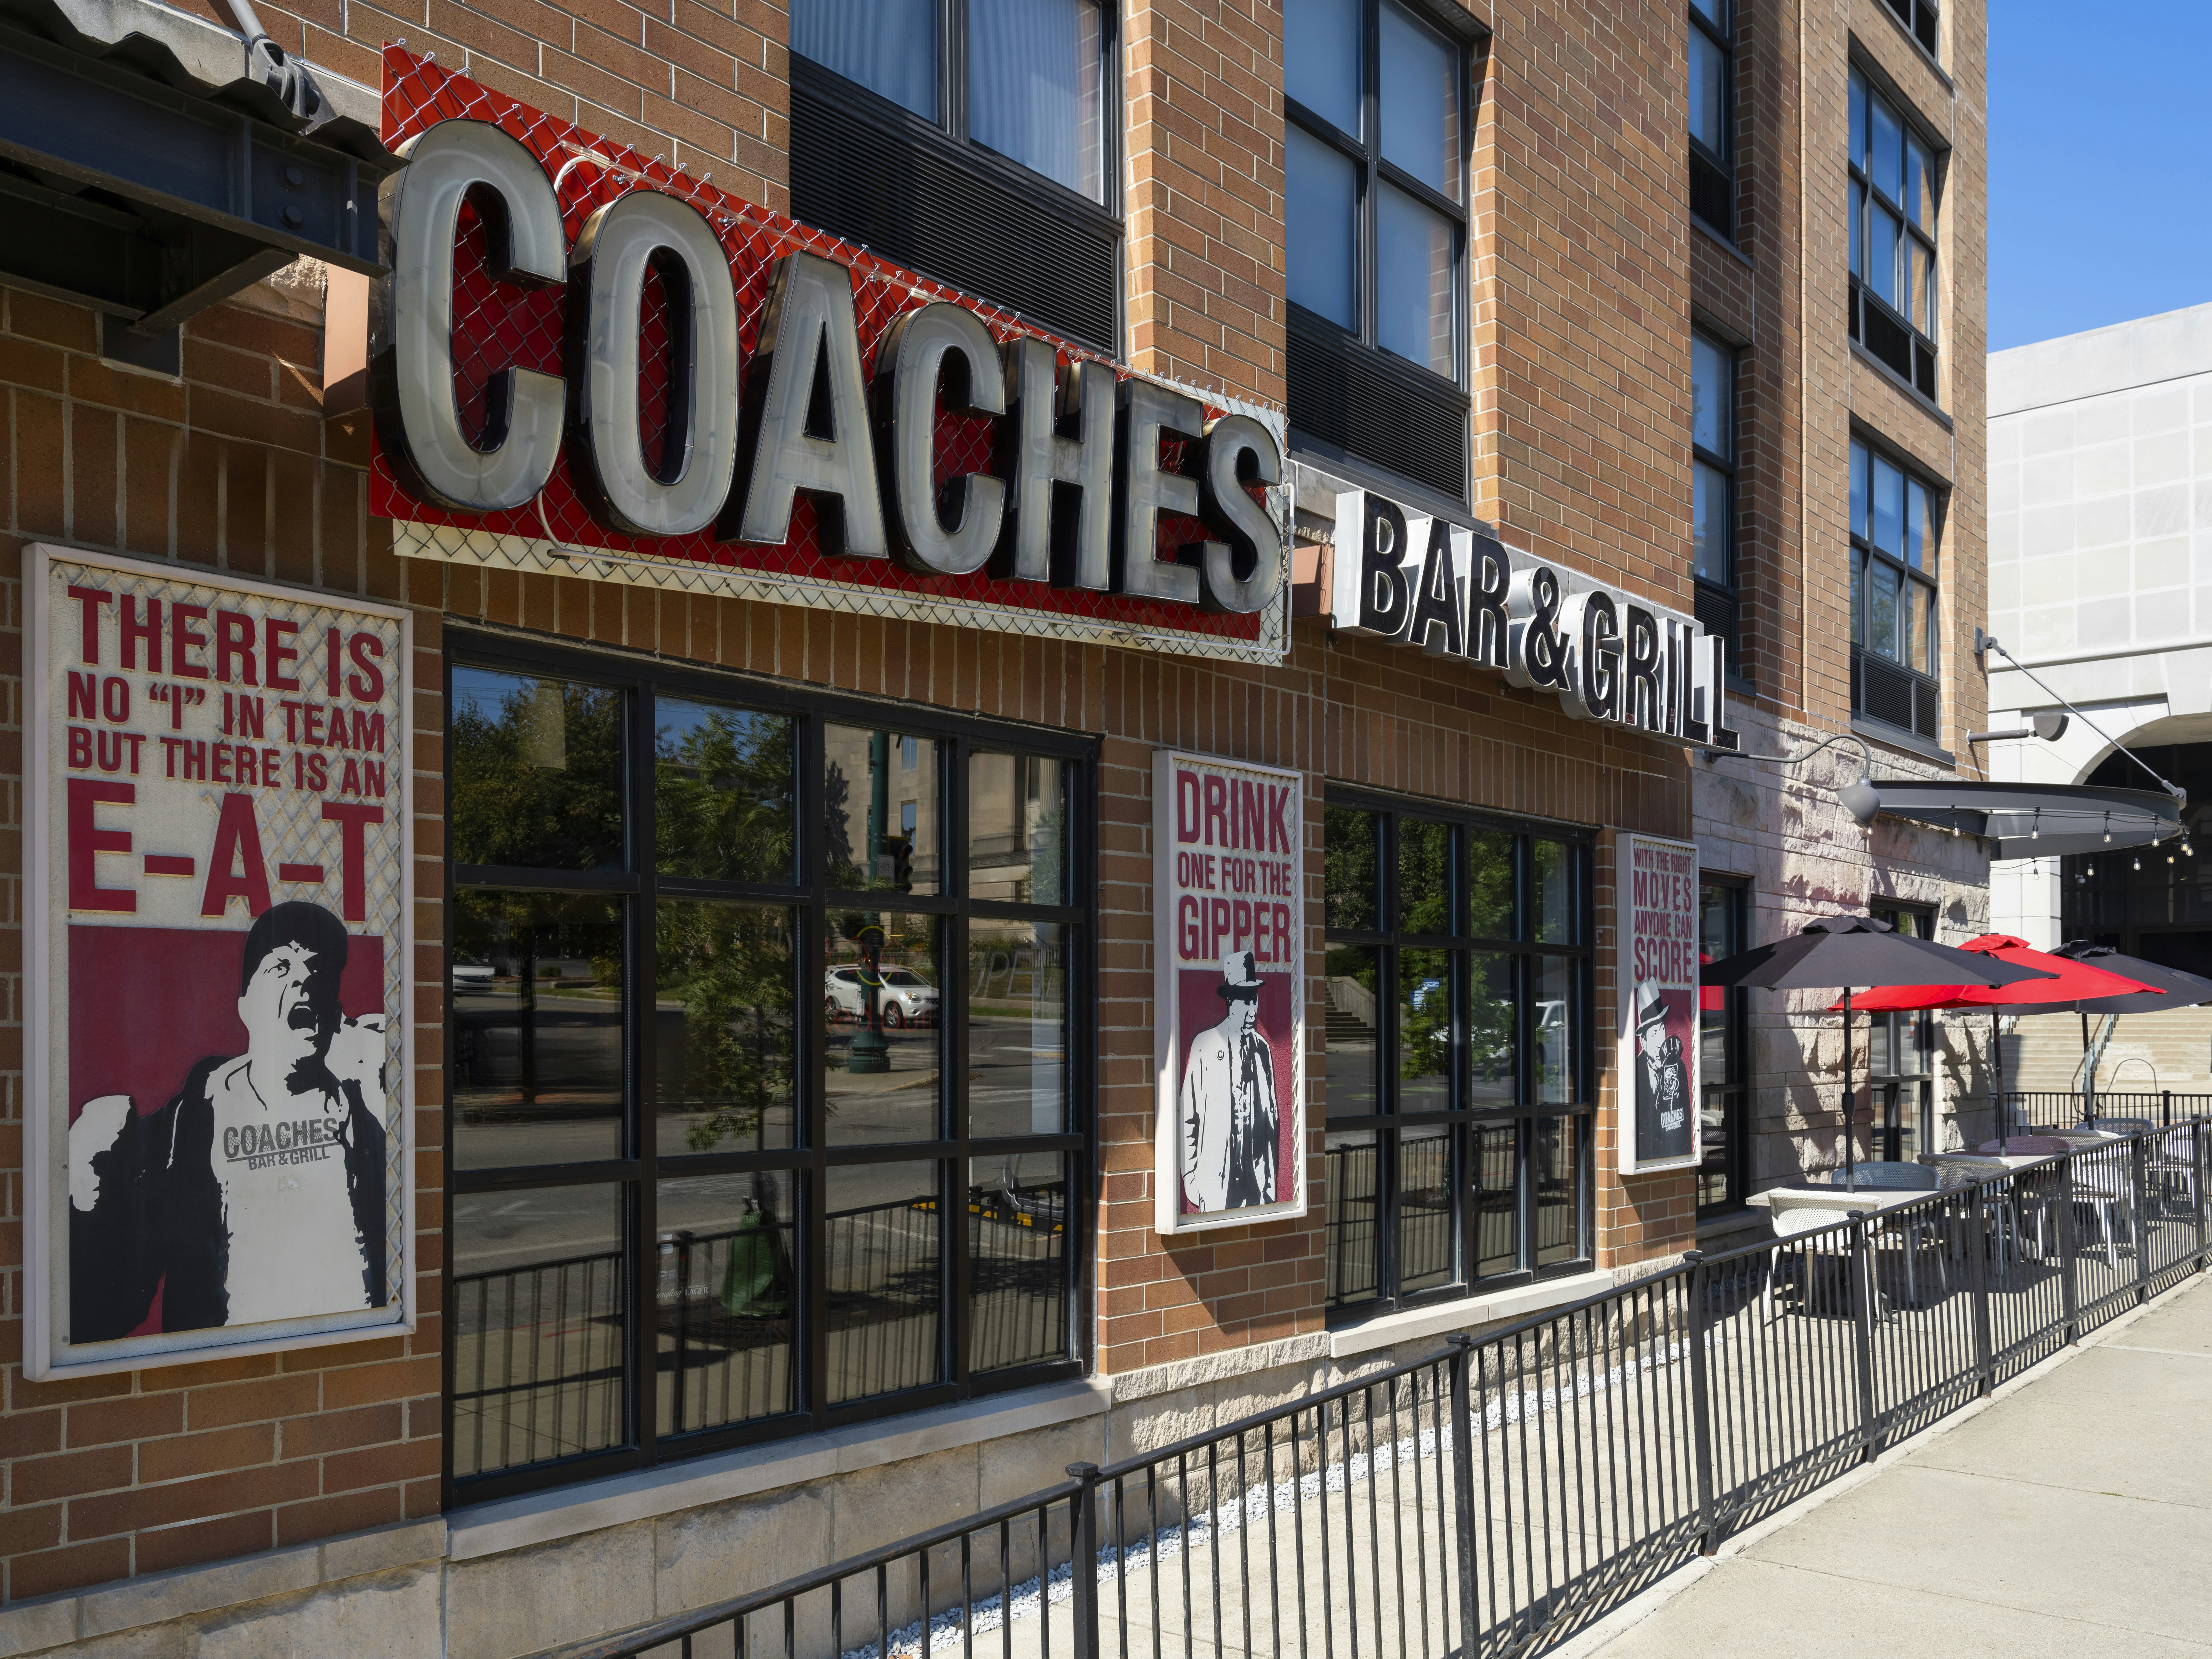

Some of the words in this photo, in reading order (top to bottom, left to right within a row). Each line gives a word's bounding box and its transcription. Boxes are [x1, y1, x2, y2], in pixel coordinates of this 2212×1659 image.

[382, 117, 1282, 614] COACHES
[1332, 490, 1510, 670] BAR
[1504, 566, 1571, 692] &
[1559, 591, 1739, 752] GRILL
[68, 585, 299, 692] THERE
[327, 628, 384, 703] IS
[68, 671, 130, 723] NO
[223, 693, 264, 739] IN
[280, 702, 384, 753] TEAM
[68, 726, 146, 775] BUT
[160, 737, 281, 788] THERE
[295, 752, 327, 792] IS
[340, 758, 385, 798] AN
[1177, 770, 1290, 854] DRINK
[1178, 852, 1215, 890] ONE
[1221, 856, 1255, 893] FOR
[1259, 861, 1291, 896] THE
[1633, 848, 1653, 869] WITH
[1655, 851, 1669, 871] THE
[1671, 855, 1691, 874] RIGHT
[1634, 870, 1692, 912] MOVES
[1178, 895, 1291, 963] GIPPER
[1634, 910, 1671, 937] ANYONE
[1674, 914, 1692, 939] CAN
[1635, 937, 1692, 983] SCORE
[1661, 1038, 1680, 1056] WIN
[223, 1117, 338, 1159] COACHES
[1660, 1108, 1683, 1126] COACHES
[1673, 1121, 1681, 1129] GRILL
[248, 1153, 276, 1171] BAR
[278, 1153, 289, 1165] &
[290, 1147, 330, 1165] GRILL
[656, 1286, 684, 1301] uengling
[685, 1286, 709, 1296] LAGER
